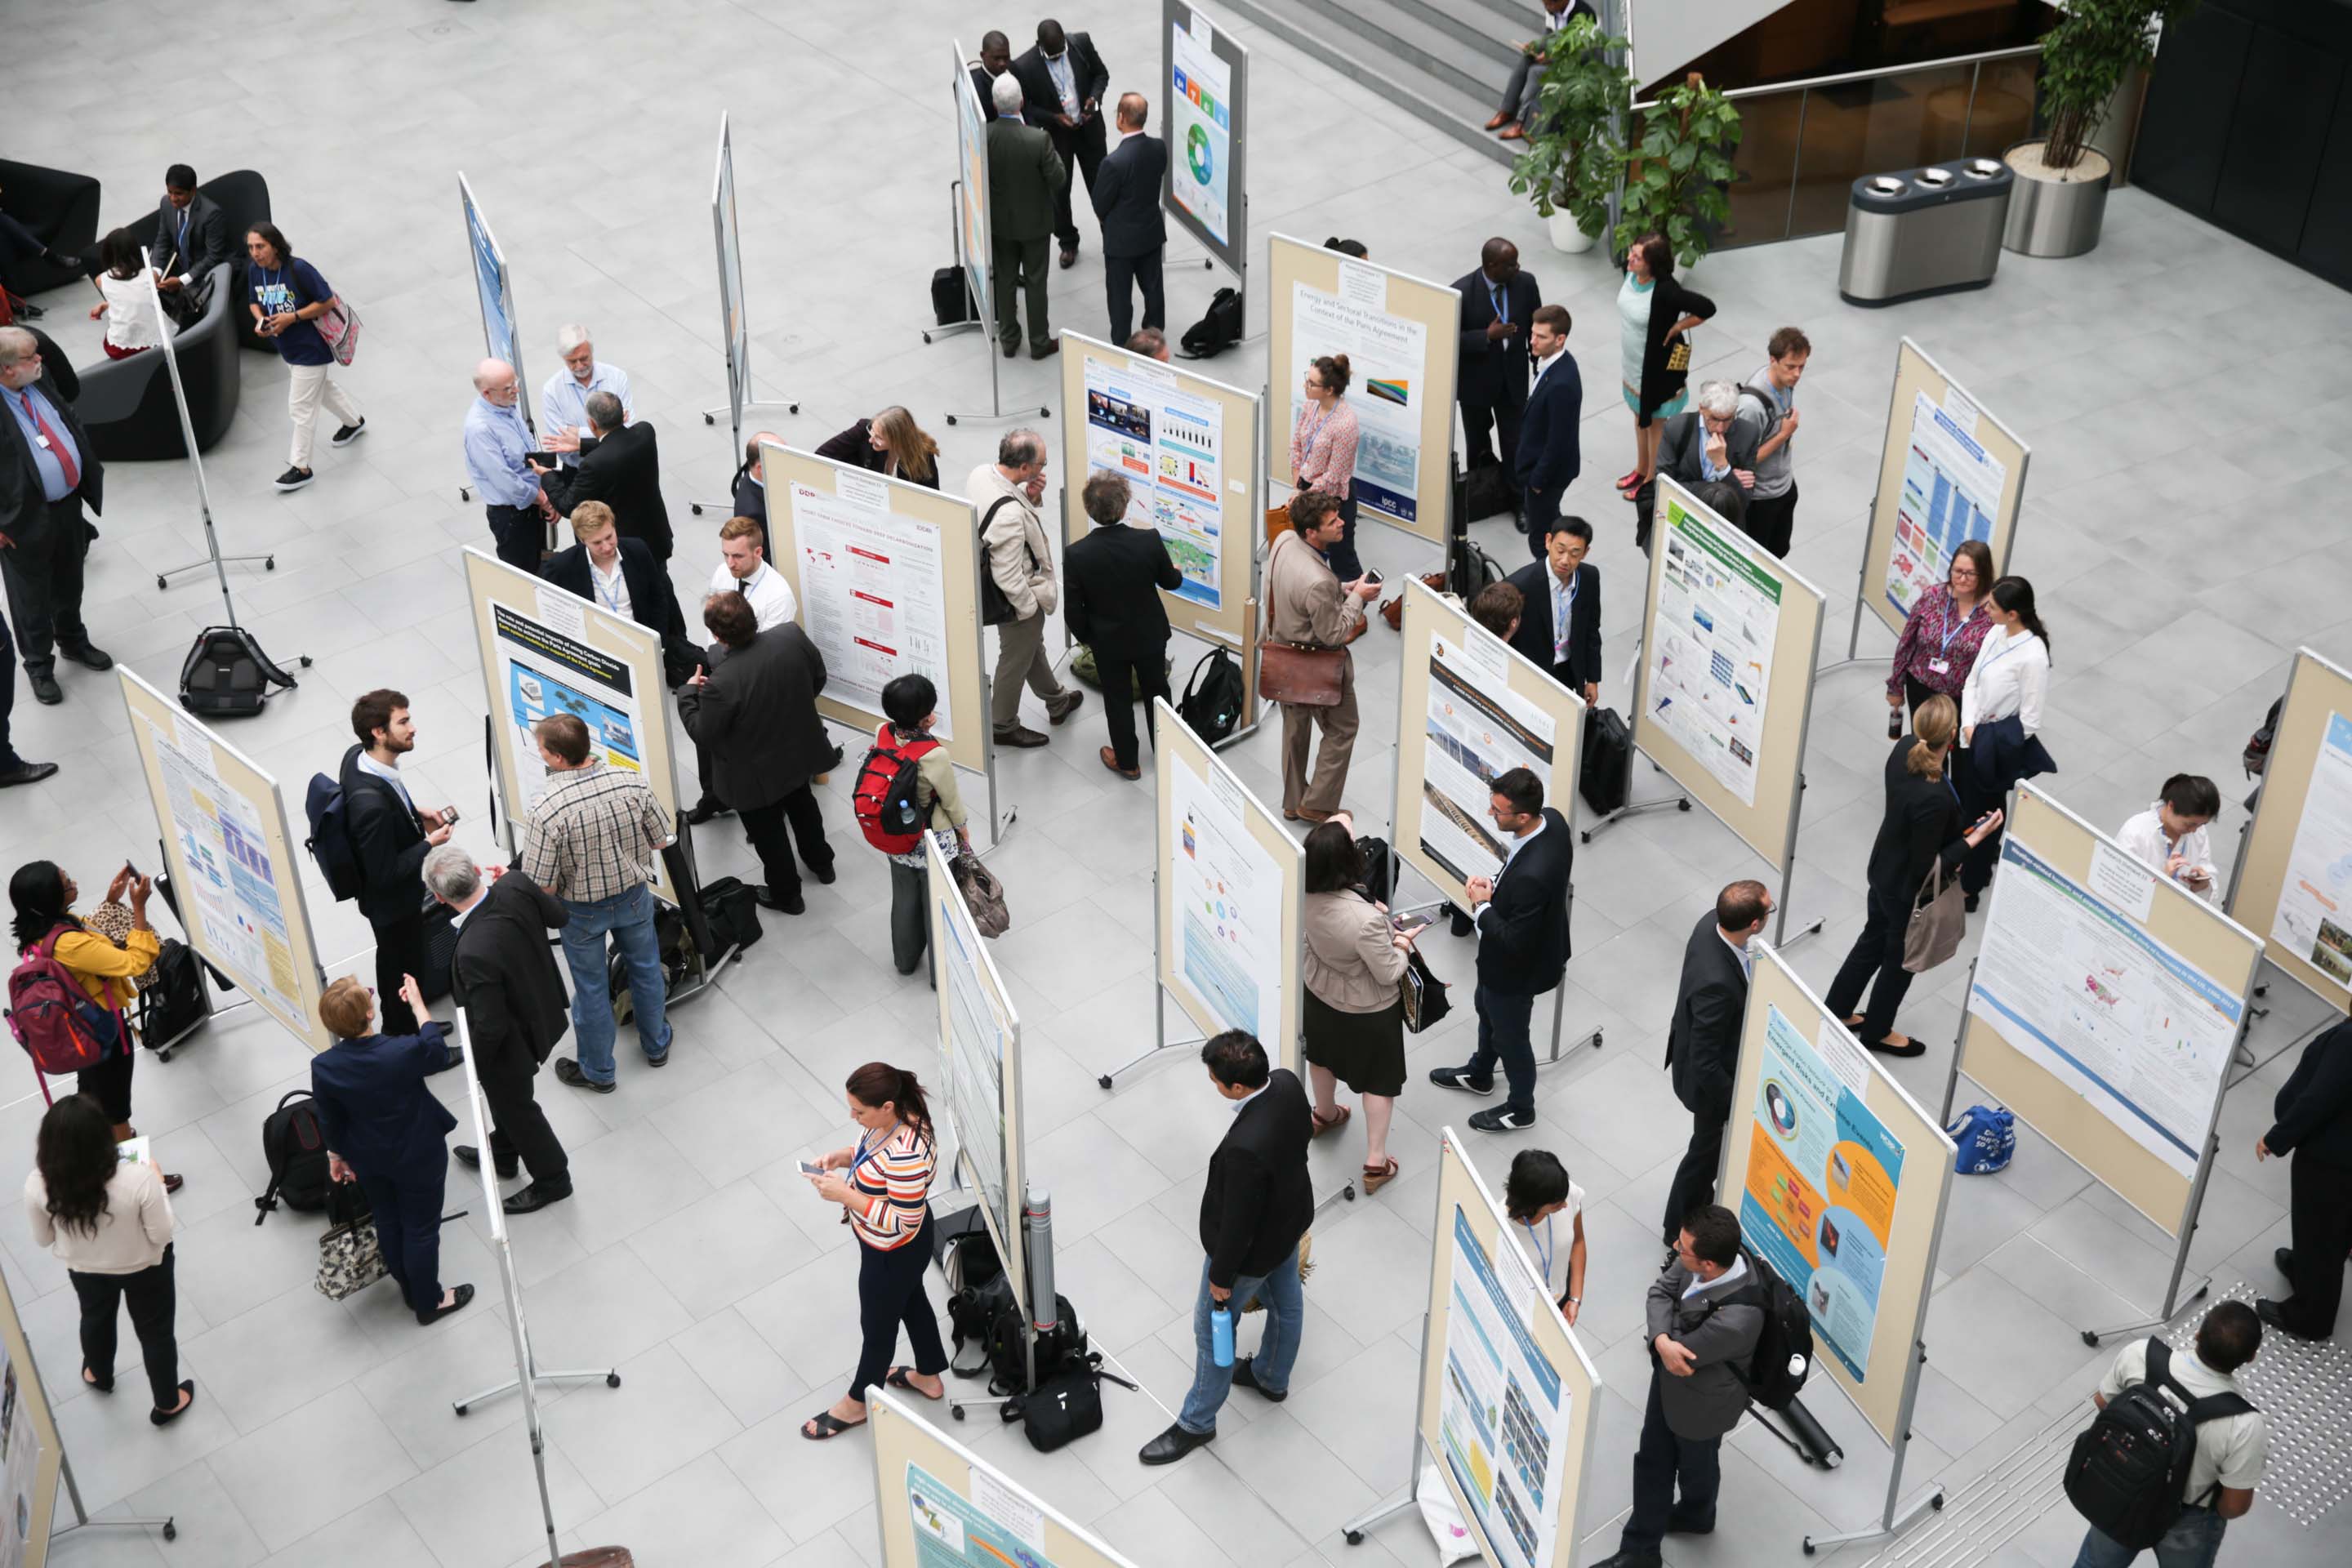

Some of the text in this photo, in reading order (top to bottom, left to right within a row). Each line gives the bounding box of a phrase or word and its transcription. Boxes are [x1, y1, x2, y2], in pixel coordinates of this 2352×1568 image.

[1300, 289, 1321, 305] Energy
[1323, 297, 1335, 307] and
[1336, 302, 1361, 316] Sectoral
[1310, 305, 1334, 320] Context
[1356, 319, 1372, 332] Paris
[1372, 326, 1408, 344] Agreement
[549, 639, 563, 651] Paris
[562, 647, 587, 663] Agreement
[584, 648, 601, 663] Carbon
[601, 657, 620, 671] Dioxide
[1768, 1030, 1794, 1066] Emergent
[1796, 1062, 1811, 1084] Risks
[1813, 1084, 1824, 1098] and
[1826, 1095, 1851, 1126] Extreme
[1851, 1124, 1873, 1152] Events
